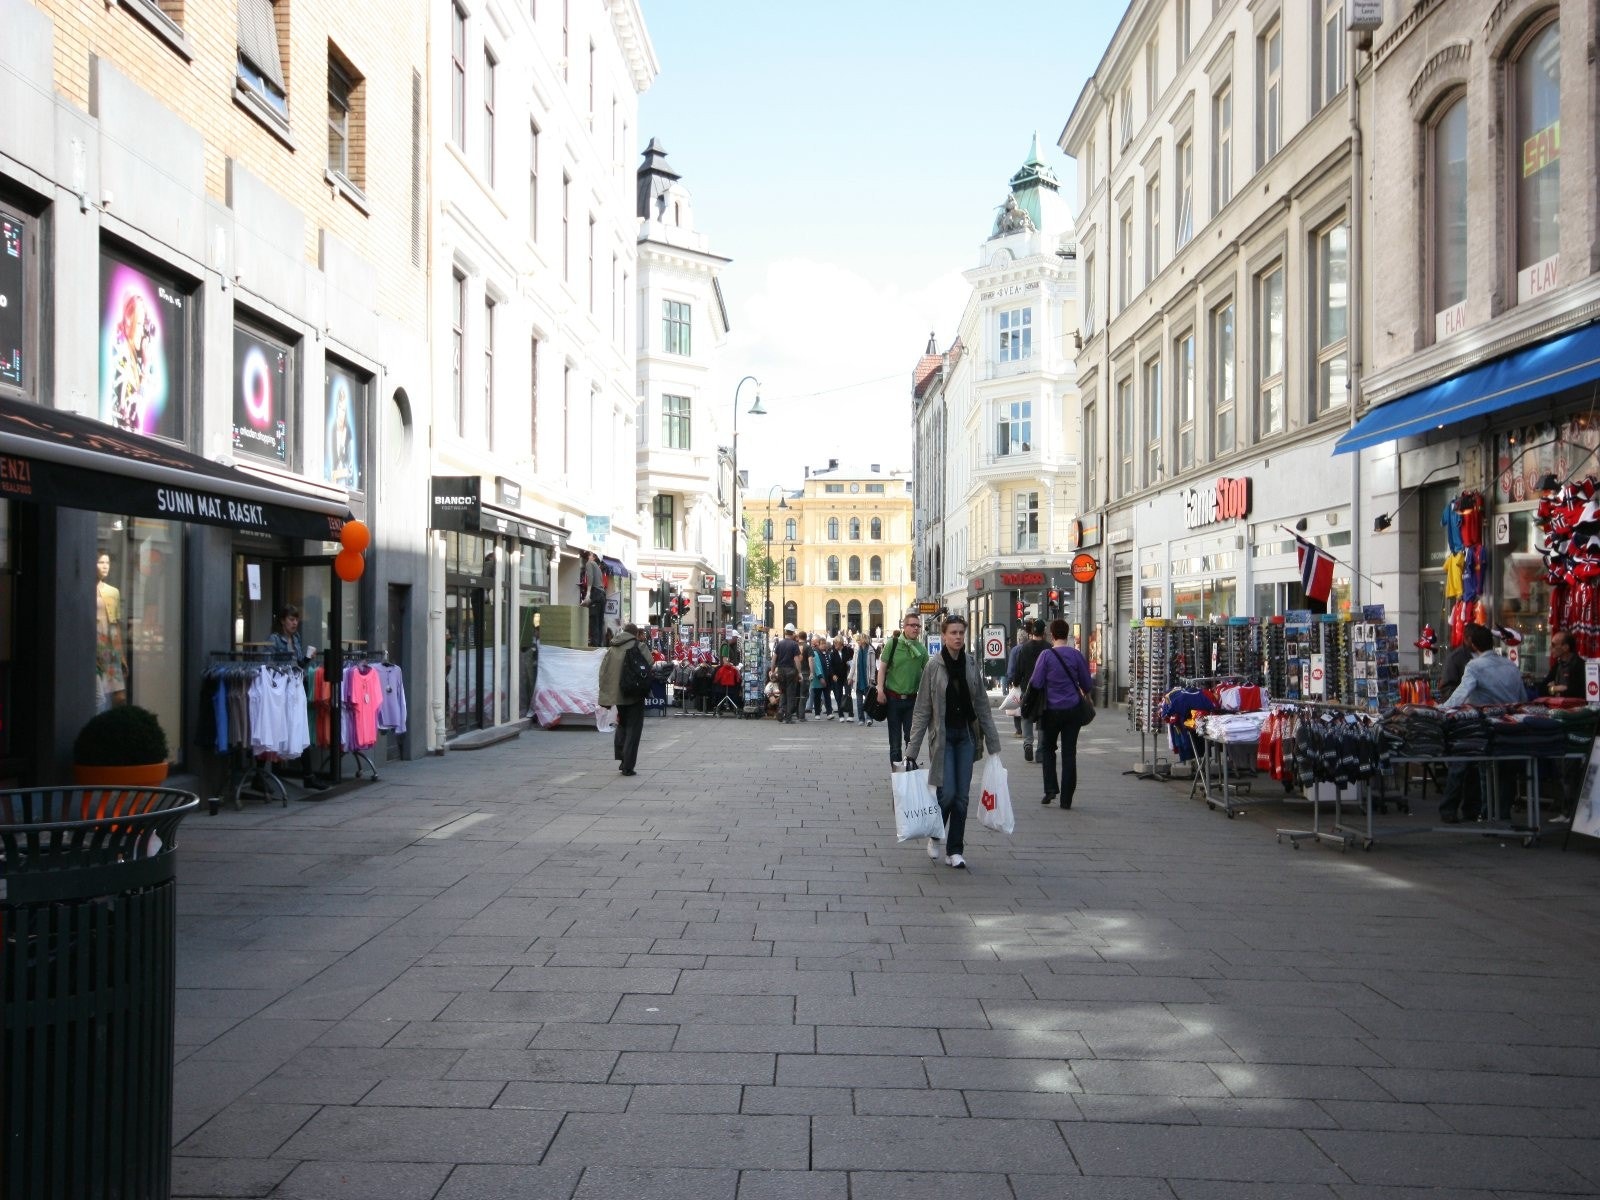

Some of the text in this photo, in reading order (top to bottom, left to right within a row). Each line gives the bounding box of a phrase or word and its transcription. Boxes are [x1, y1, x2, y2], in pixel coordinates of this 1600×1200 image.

[157, 488, 268, 526] SUNN MAT. RASKT.
[1183, 476, 1248, 530] GameStop
[989, 643, 1000, 652] 30
